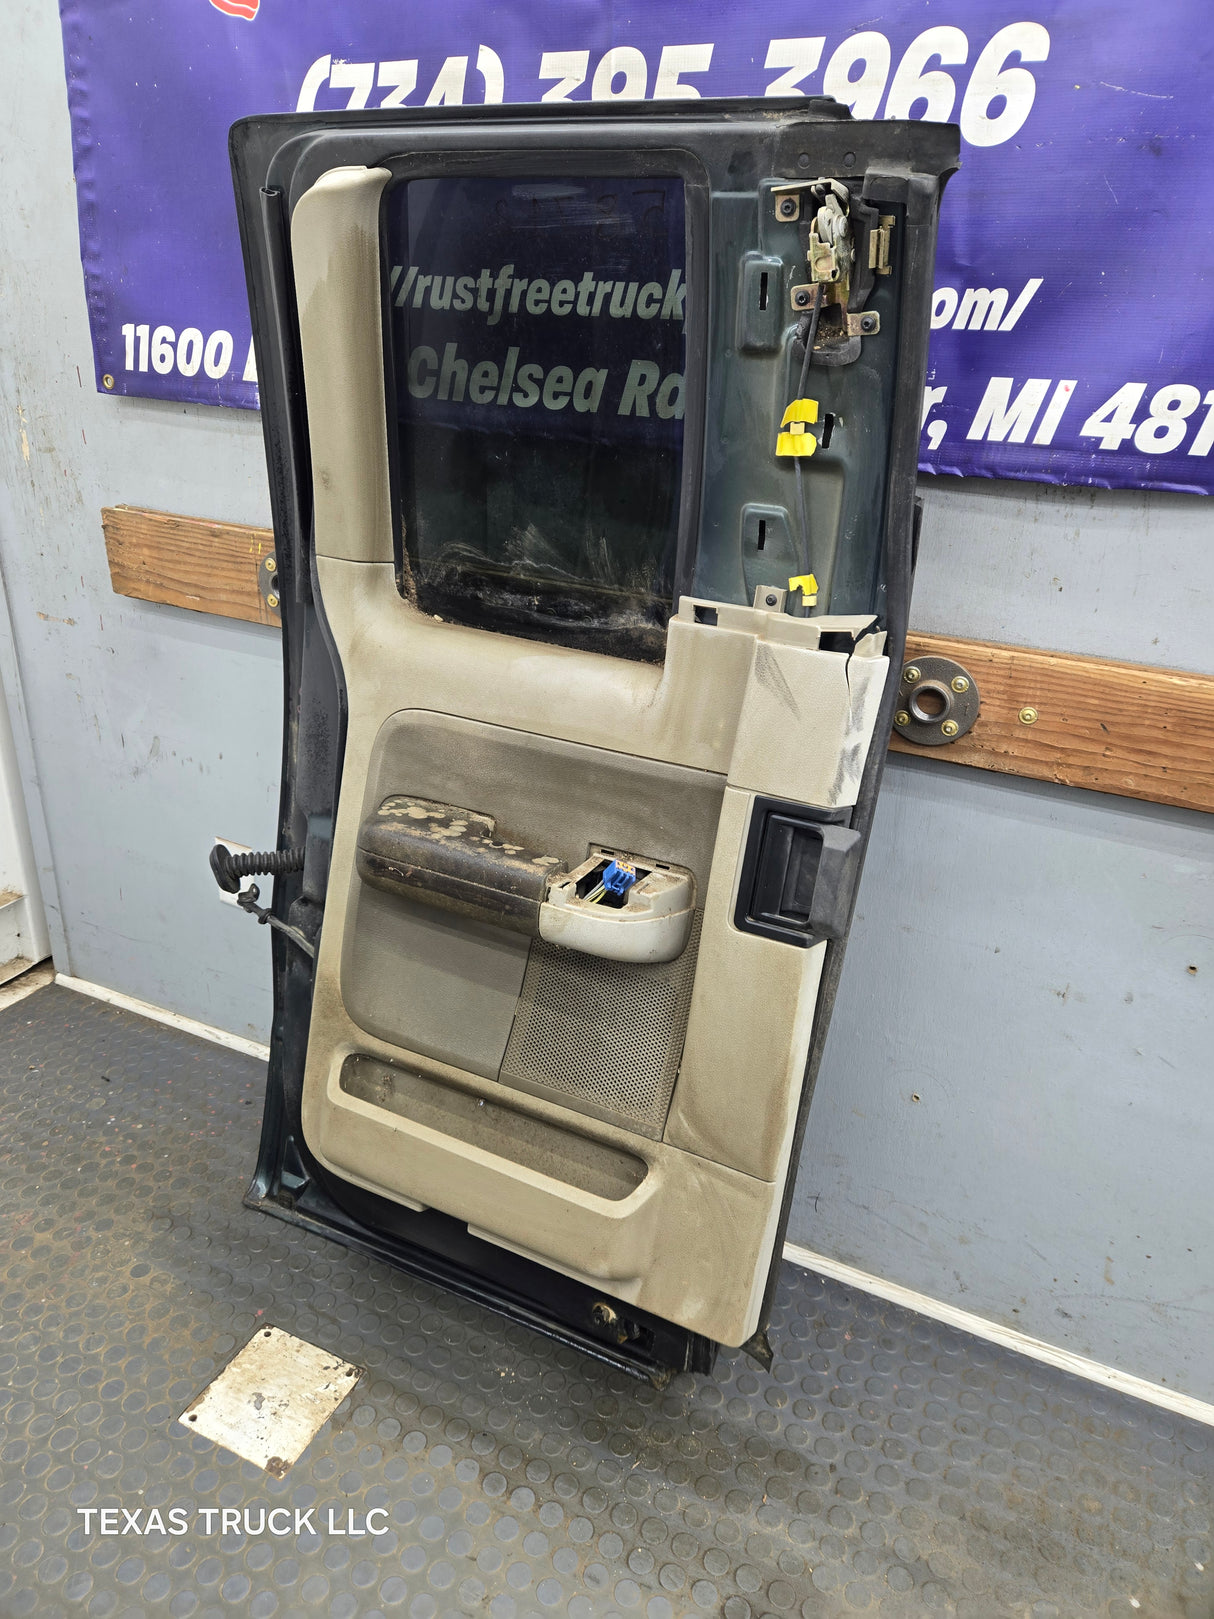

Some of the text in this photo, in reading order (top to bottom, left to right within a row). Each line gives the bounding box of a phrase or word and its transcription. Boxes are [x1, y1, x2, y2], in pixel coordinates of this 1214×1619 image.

[121, 323, 234, 380] 11600
[407, 342, 608, 413] Chelsea
[966, 376, 1078, 445] MI
